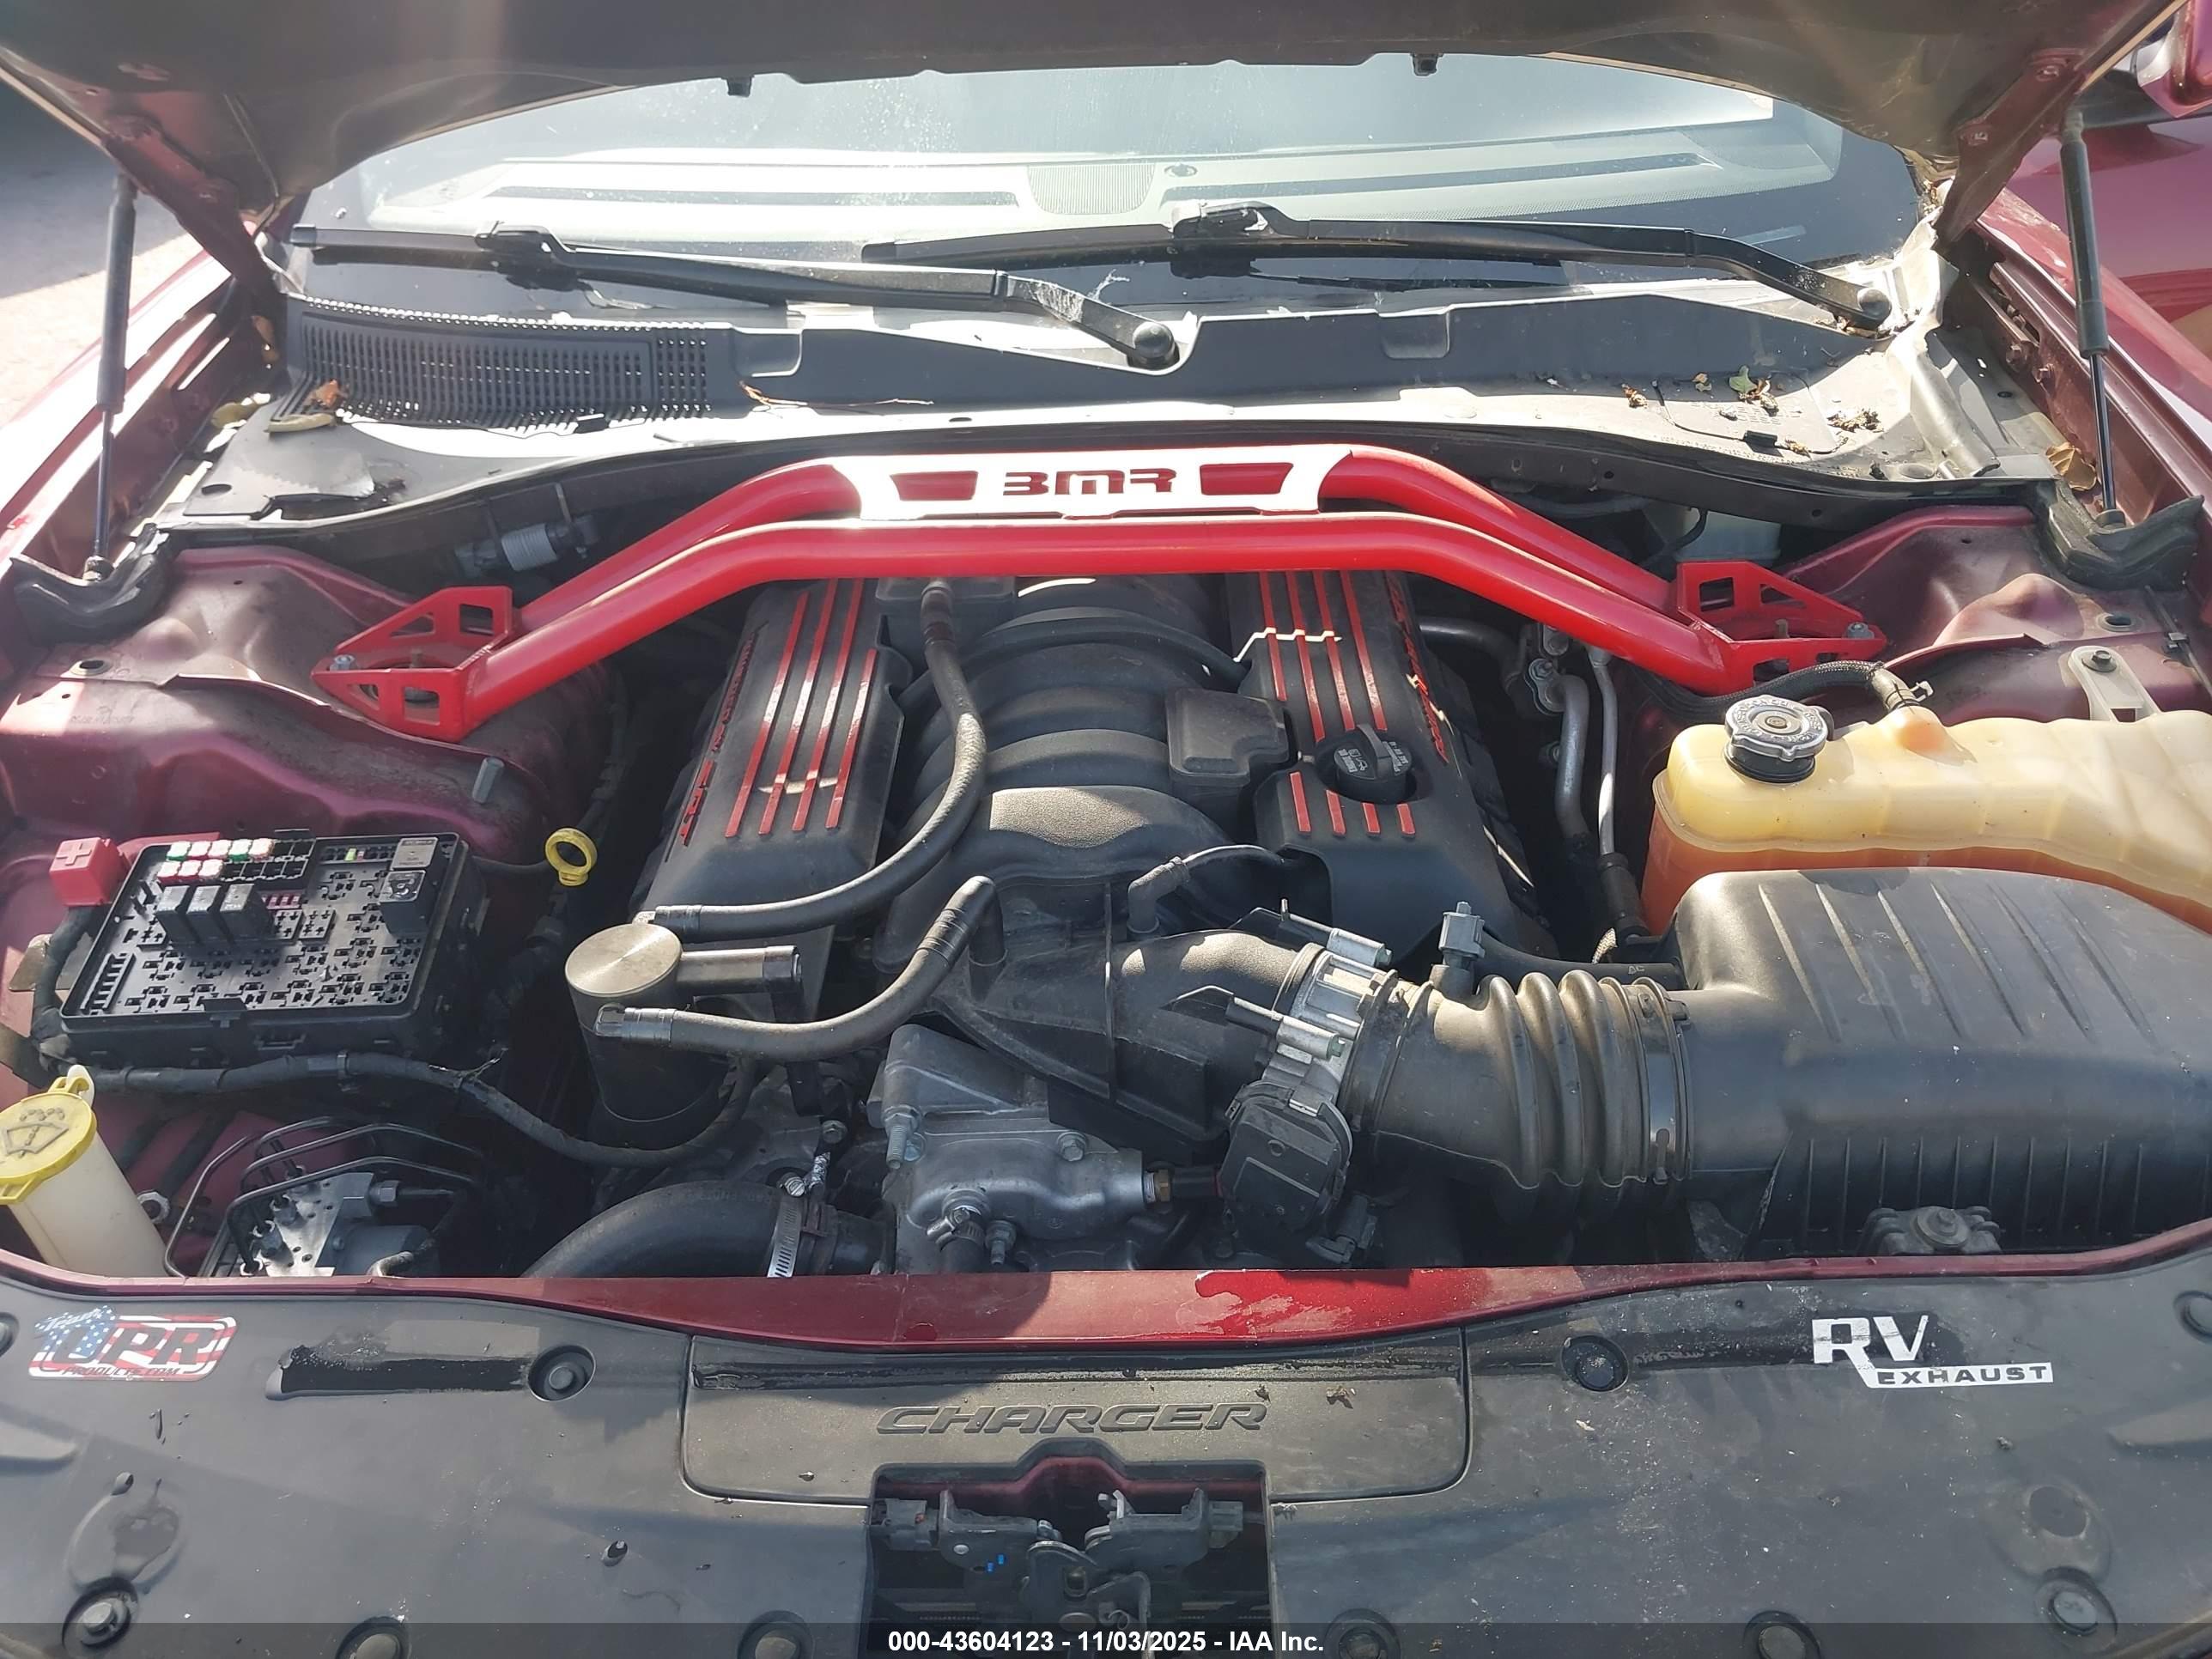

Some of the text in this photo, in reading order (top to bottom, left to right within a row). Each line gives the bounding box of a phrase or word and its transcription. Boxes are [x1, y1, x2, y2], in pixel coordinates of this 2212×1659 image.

[1003, 468, 1176, 495] BMR
[1812, 1315, 1929, 1369] RV
[1877, 1365, 2047, 1385] EXHAUST
[876, 1401, 1269, 1434] CHARGER
